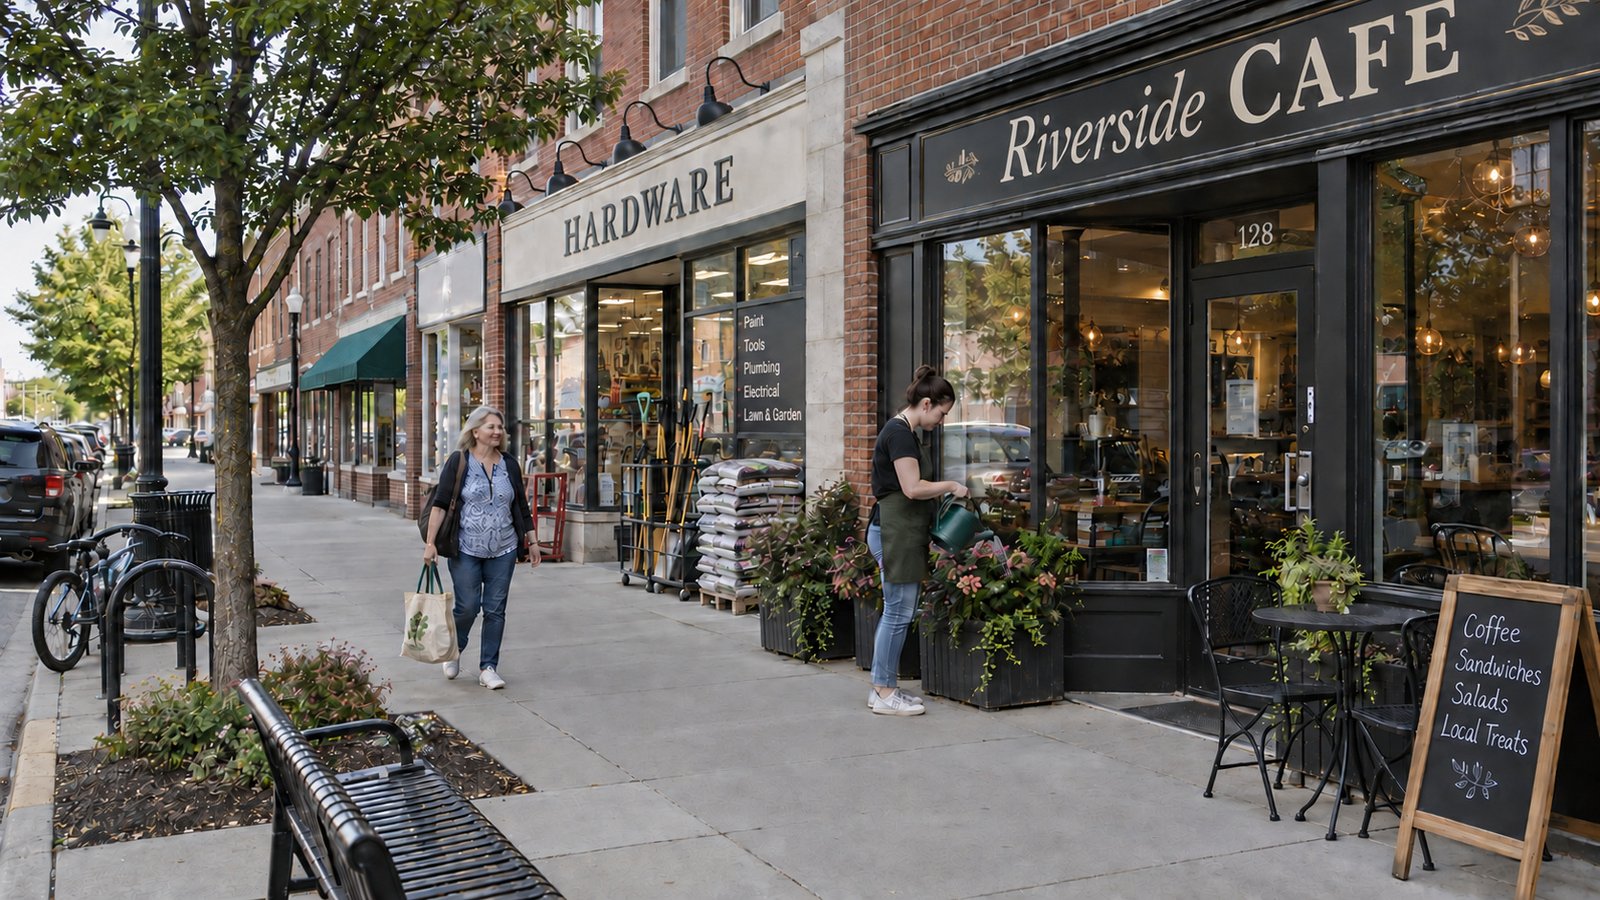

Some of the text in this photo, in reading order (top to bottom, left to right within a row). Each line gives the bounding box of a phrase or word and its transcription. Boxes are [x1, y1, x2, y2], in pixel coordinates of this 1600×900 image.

[999, 0, 1460, 183] Riverside CAFE
[564, 154, 735, 257] HARDWARE
[1238, 222, 1273, 250] 128
[743, 314, 765, 329] Paint
[743, 338, 766, 353] Tools
[743, 360, 781, 377] Plumbing
[743, 382, 780, 399] Electrical
[743, 407, 802, 422] Lawn & Garden
[1463, 612, 1521, 645] Coffee
[1455, 648, 1542, 686] Sandwiches
[1451, 682, 1509, 714] Salads
[1441, 714, 1529, 756] Local Treats
